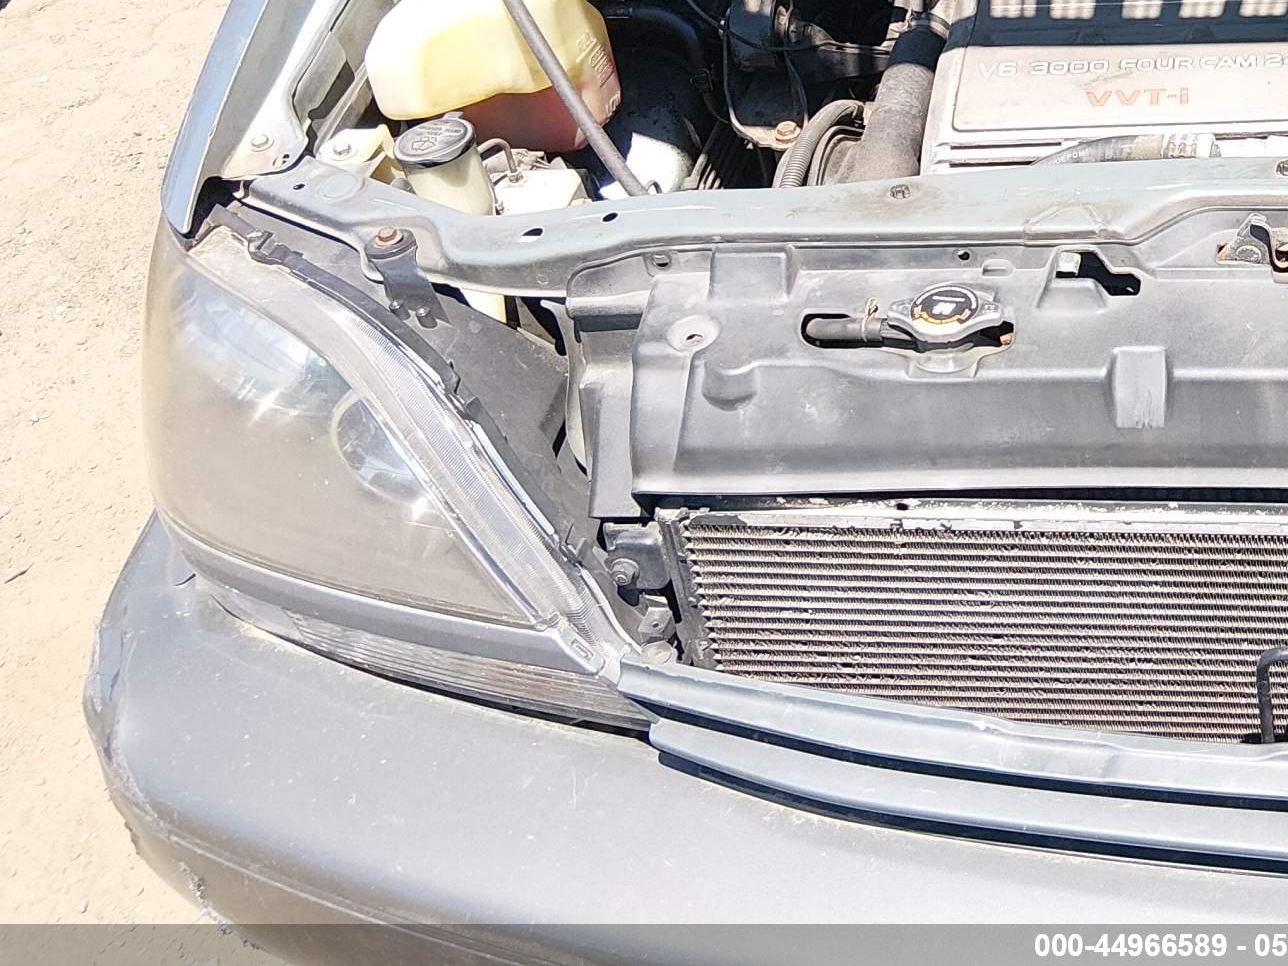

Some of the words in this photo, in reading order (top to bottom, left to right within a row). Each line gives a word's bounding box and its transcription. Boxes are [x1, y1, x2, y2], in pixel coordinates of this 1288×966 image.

[977, 60, 1017, 78] V6
[1029, 59, 1109, 76] 3000
[1120, 56, 1193, 73] FOUR
[1199, 55, 1258, 70] CAM
[1086, 87, 1190, 107] VVT-i
